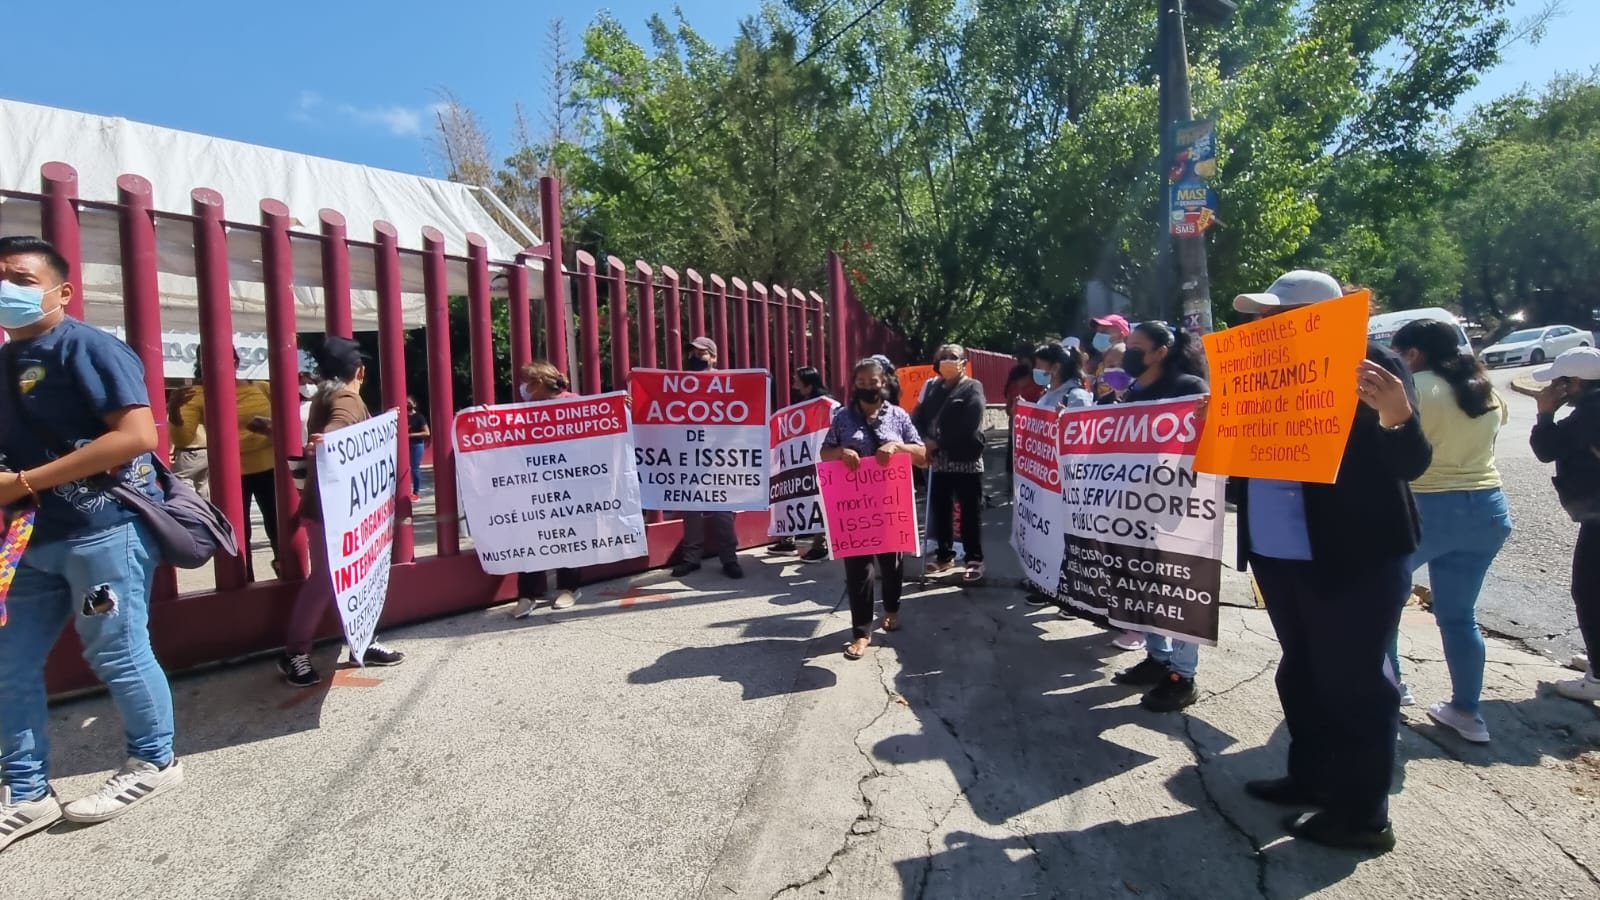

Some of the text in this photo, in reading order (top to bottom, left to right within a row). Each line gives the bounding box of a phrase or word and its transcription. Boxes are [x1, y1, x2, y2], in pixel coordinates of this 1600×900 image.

[1305, 312, 1321, 333] de
[663, 374, 735, 393] NO AL
[505, 410, 551, 426] FALTA
[555, 402, 615, 419] DINERO,
[646, 400, 749, 422] ACOSO
[1221, 401, 1230, 417] el
[1236, 398, 1272, 416] cambio
[1275, 395, 1289, 413] de
[462, 416, 622, 447] SOBRAN CORRUPTOS.
[686, 430, 705, 442] DE
[777, 409, 806, 440] NO
[1063, 410, 1197, 445] EXIGIMOS
[1242, 418, 1280, 438] recibir
[1286, 415, 1341, 437] nuestras
[526, 453, 567, 467] FUERA
[634, 447, 762, 467] SSA E ISSSTE
[779, 440, 812, 469] A LA
[1025, 437, 1058, 463] GOBIERN
[492, 463, 608, 488] BEATRIZ CISNEROS
[648, 472, 676, 485] LOS
[680, 473, 761, 486] PACIENTES
[844, 465, 907, 492] quieres
[1018, 455, 1060, 486] GUERRERO
[349, 453, 396, 518] AYUDA
[663, 490, 728, 502] RENALES
[882, 487, 900, 506] al
[1019, 483, 1035, 504] CON
[531, 490, 572, 505] FUERA
[1083, 487, 1217, 521] SERVIDORES
[488, 499, 622, 526] JOSÉ LUIS ALVARADO
[776, 501, 825, 533] EN SSA
[839, 511, 910, 533] ISSSTE
[342, 527, 359, 557] DE
[537, 527, 577, 541] FUERA
[899, 530, 910, 545] ir
[482, 547, 536, 562] MUSTAFA
[540, 540, 587, 556] CORTES
[1127, 558, 1191, 580] CORTES
[347, 585, 367, 613] QUE
[1116, 577, 1212, 605] ALVARADO
[1124, 597, 1185, 621] RAFAEL
